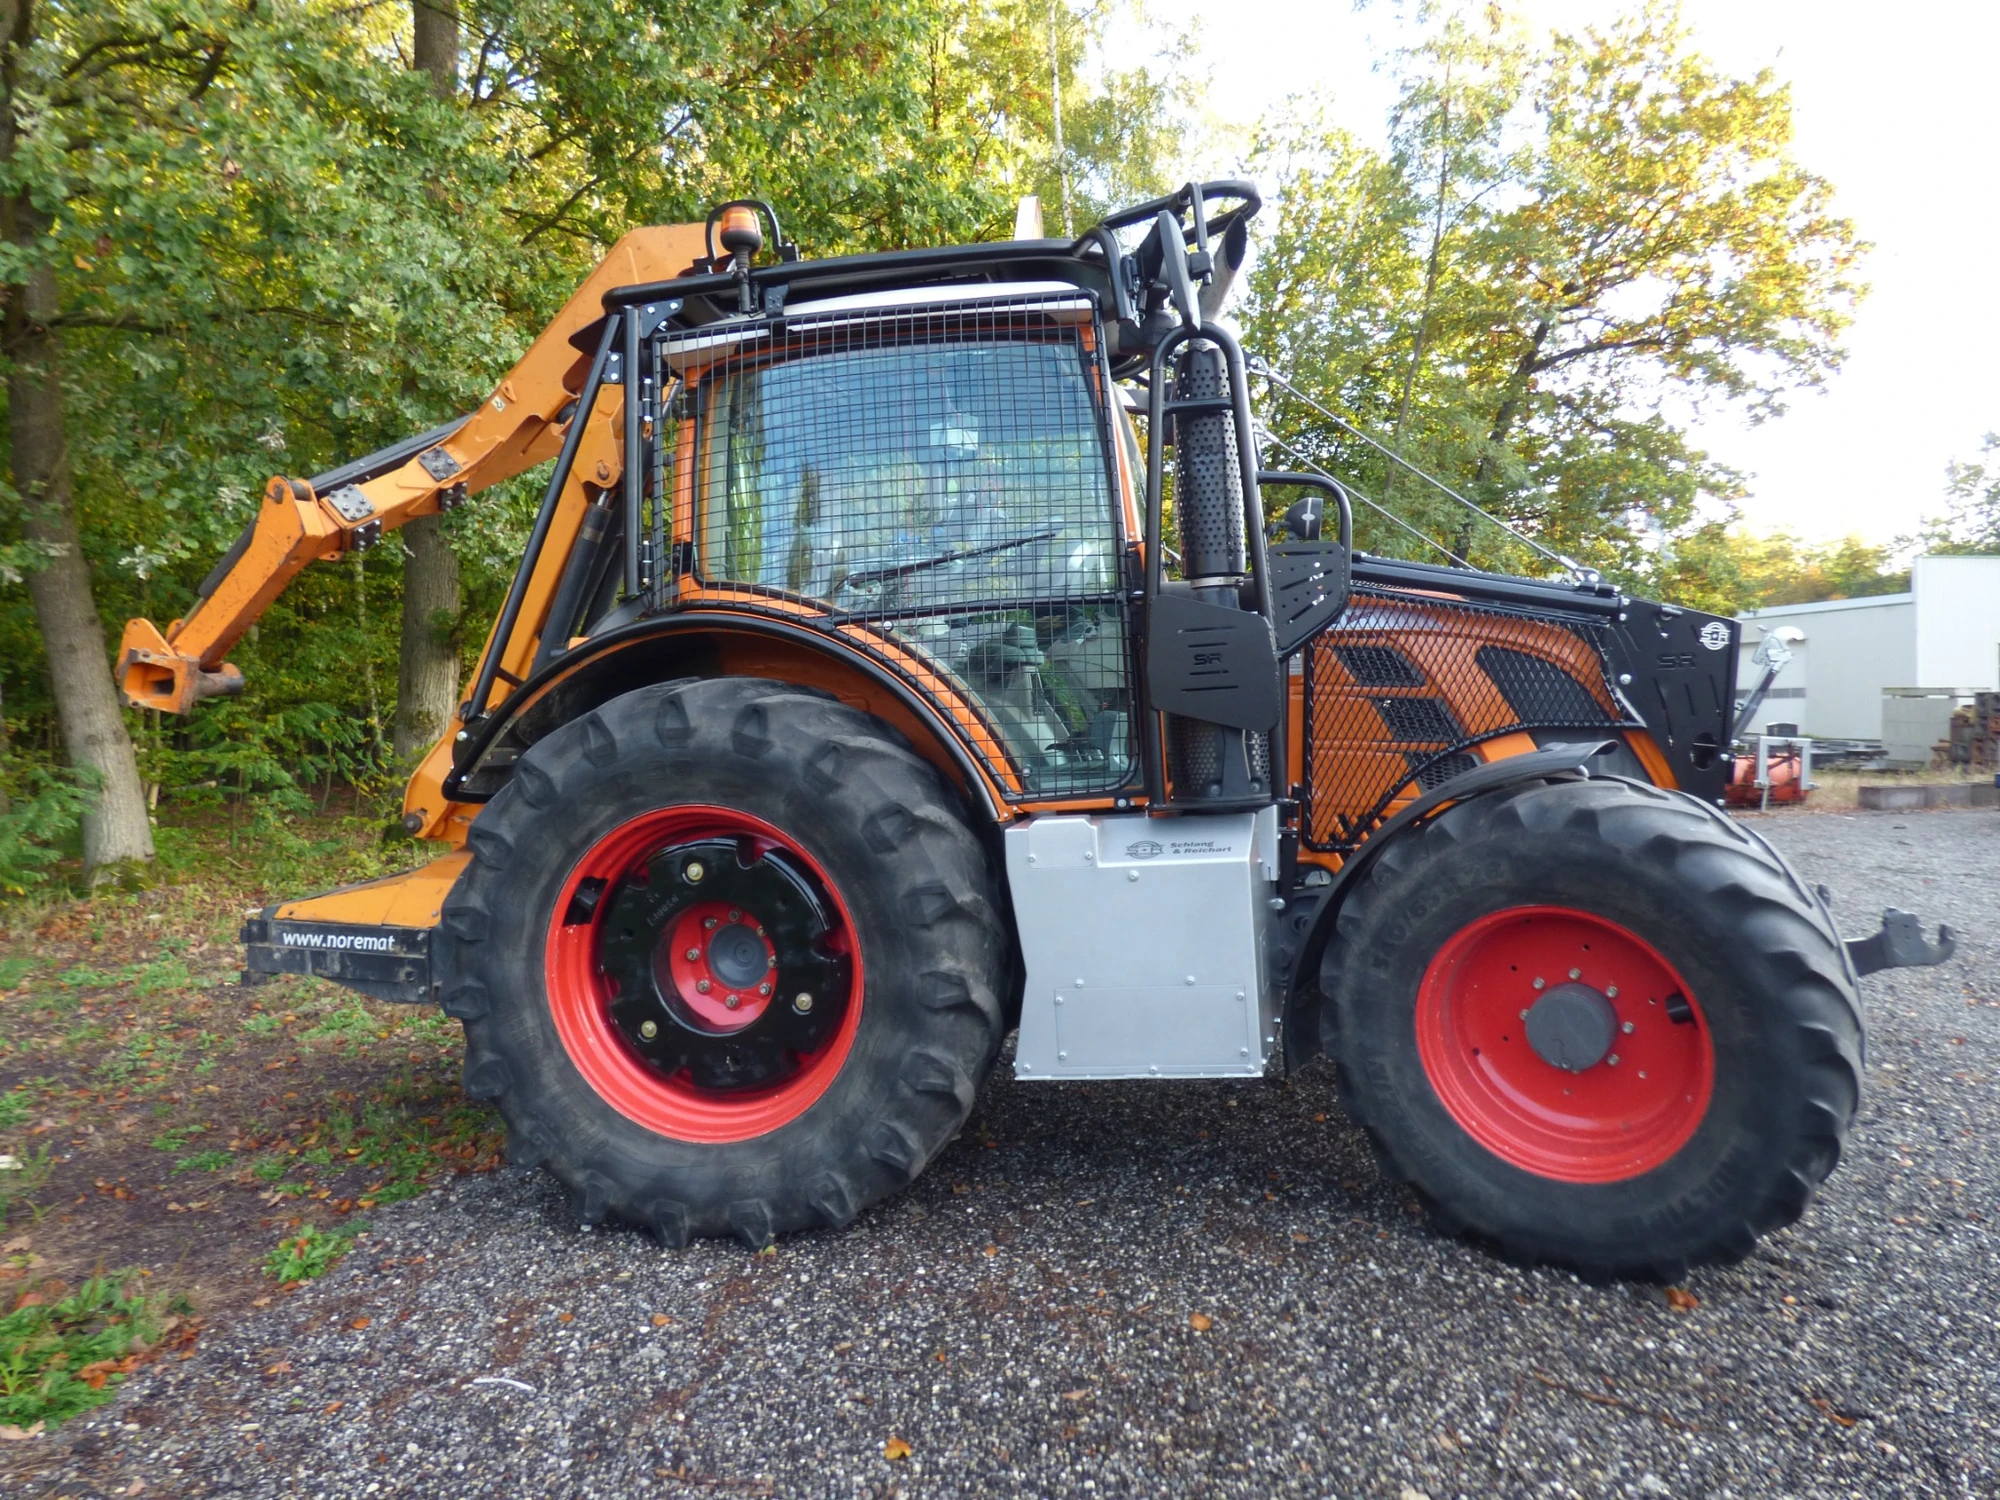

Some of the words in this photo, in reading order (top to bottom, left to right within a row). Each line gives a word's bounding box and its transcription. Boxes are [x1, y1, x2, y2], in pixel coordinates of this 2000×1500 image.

[1170, 841, 1215, 849] Schlang
[1184, 846, 1232, 855] Reichart
[283, 931, 396, 951] www.noremat
